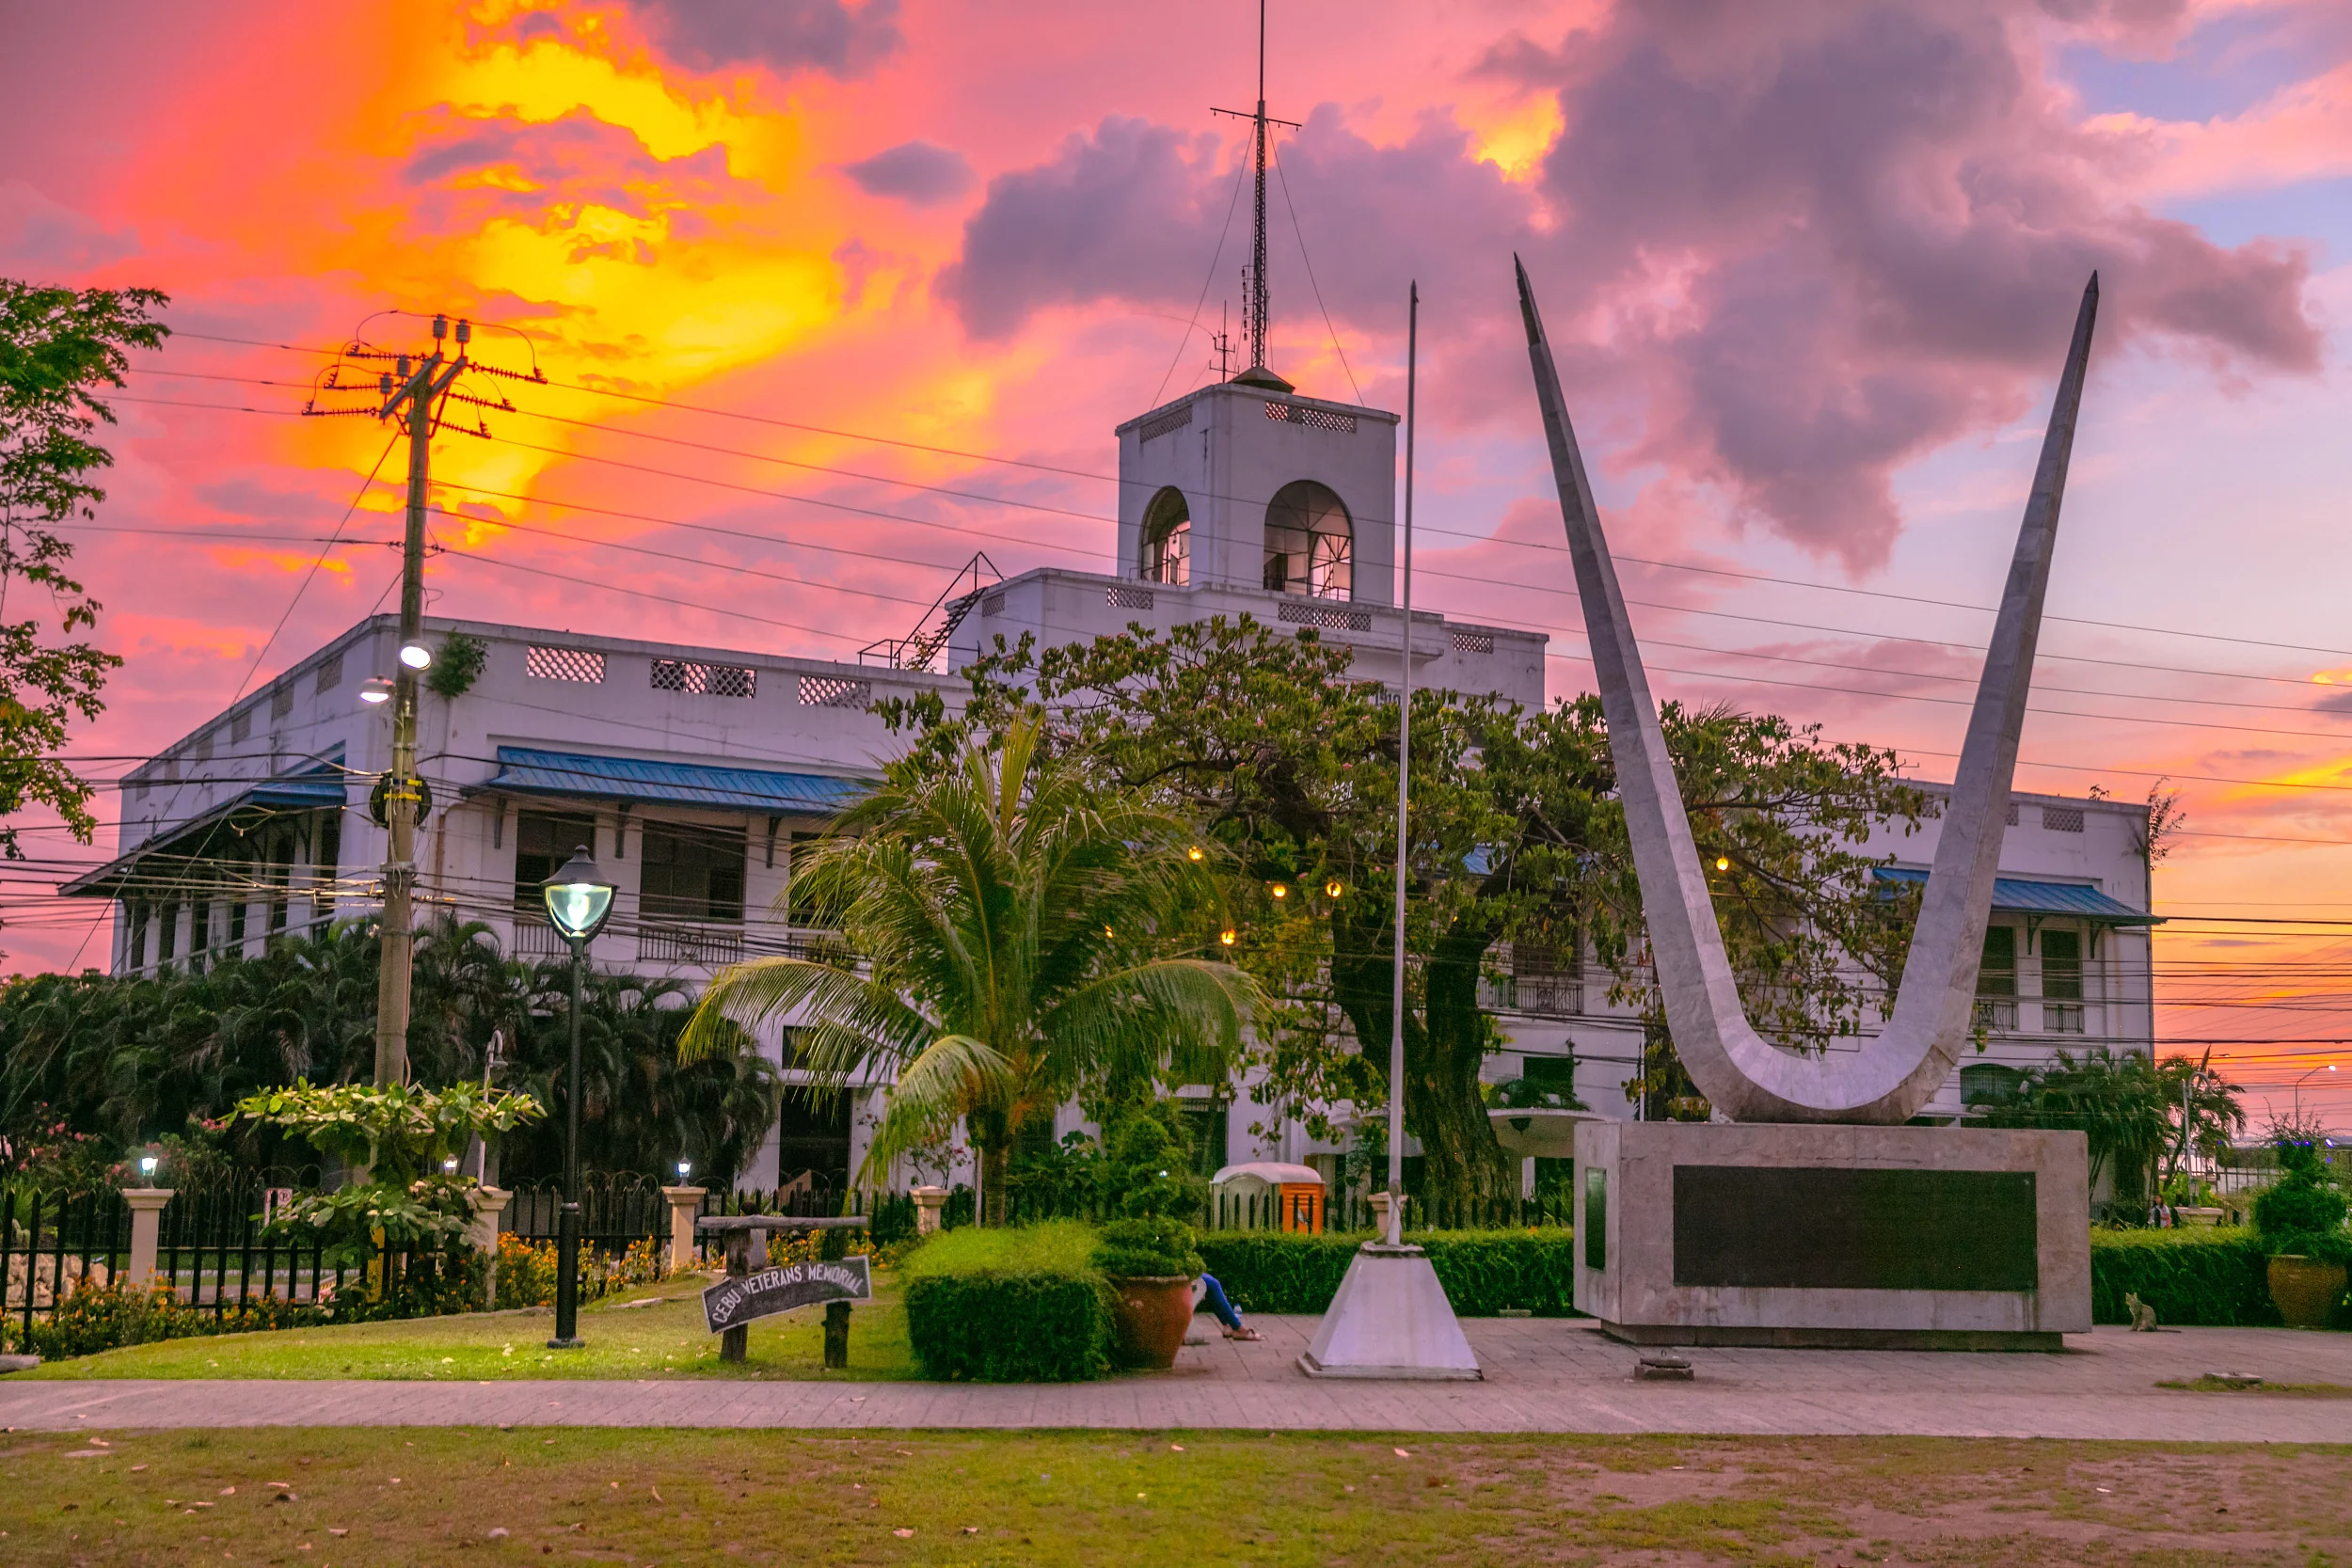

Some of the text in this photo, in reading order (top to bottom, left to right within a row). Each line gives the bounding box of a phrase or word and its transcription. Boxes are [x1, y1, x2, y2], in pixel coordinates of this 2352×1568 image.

[712, 1263, 863, 1323] CEBU VETERANS MEMORIAL
